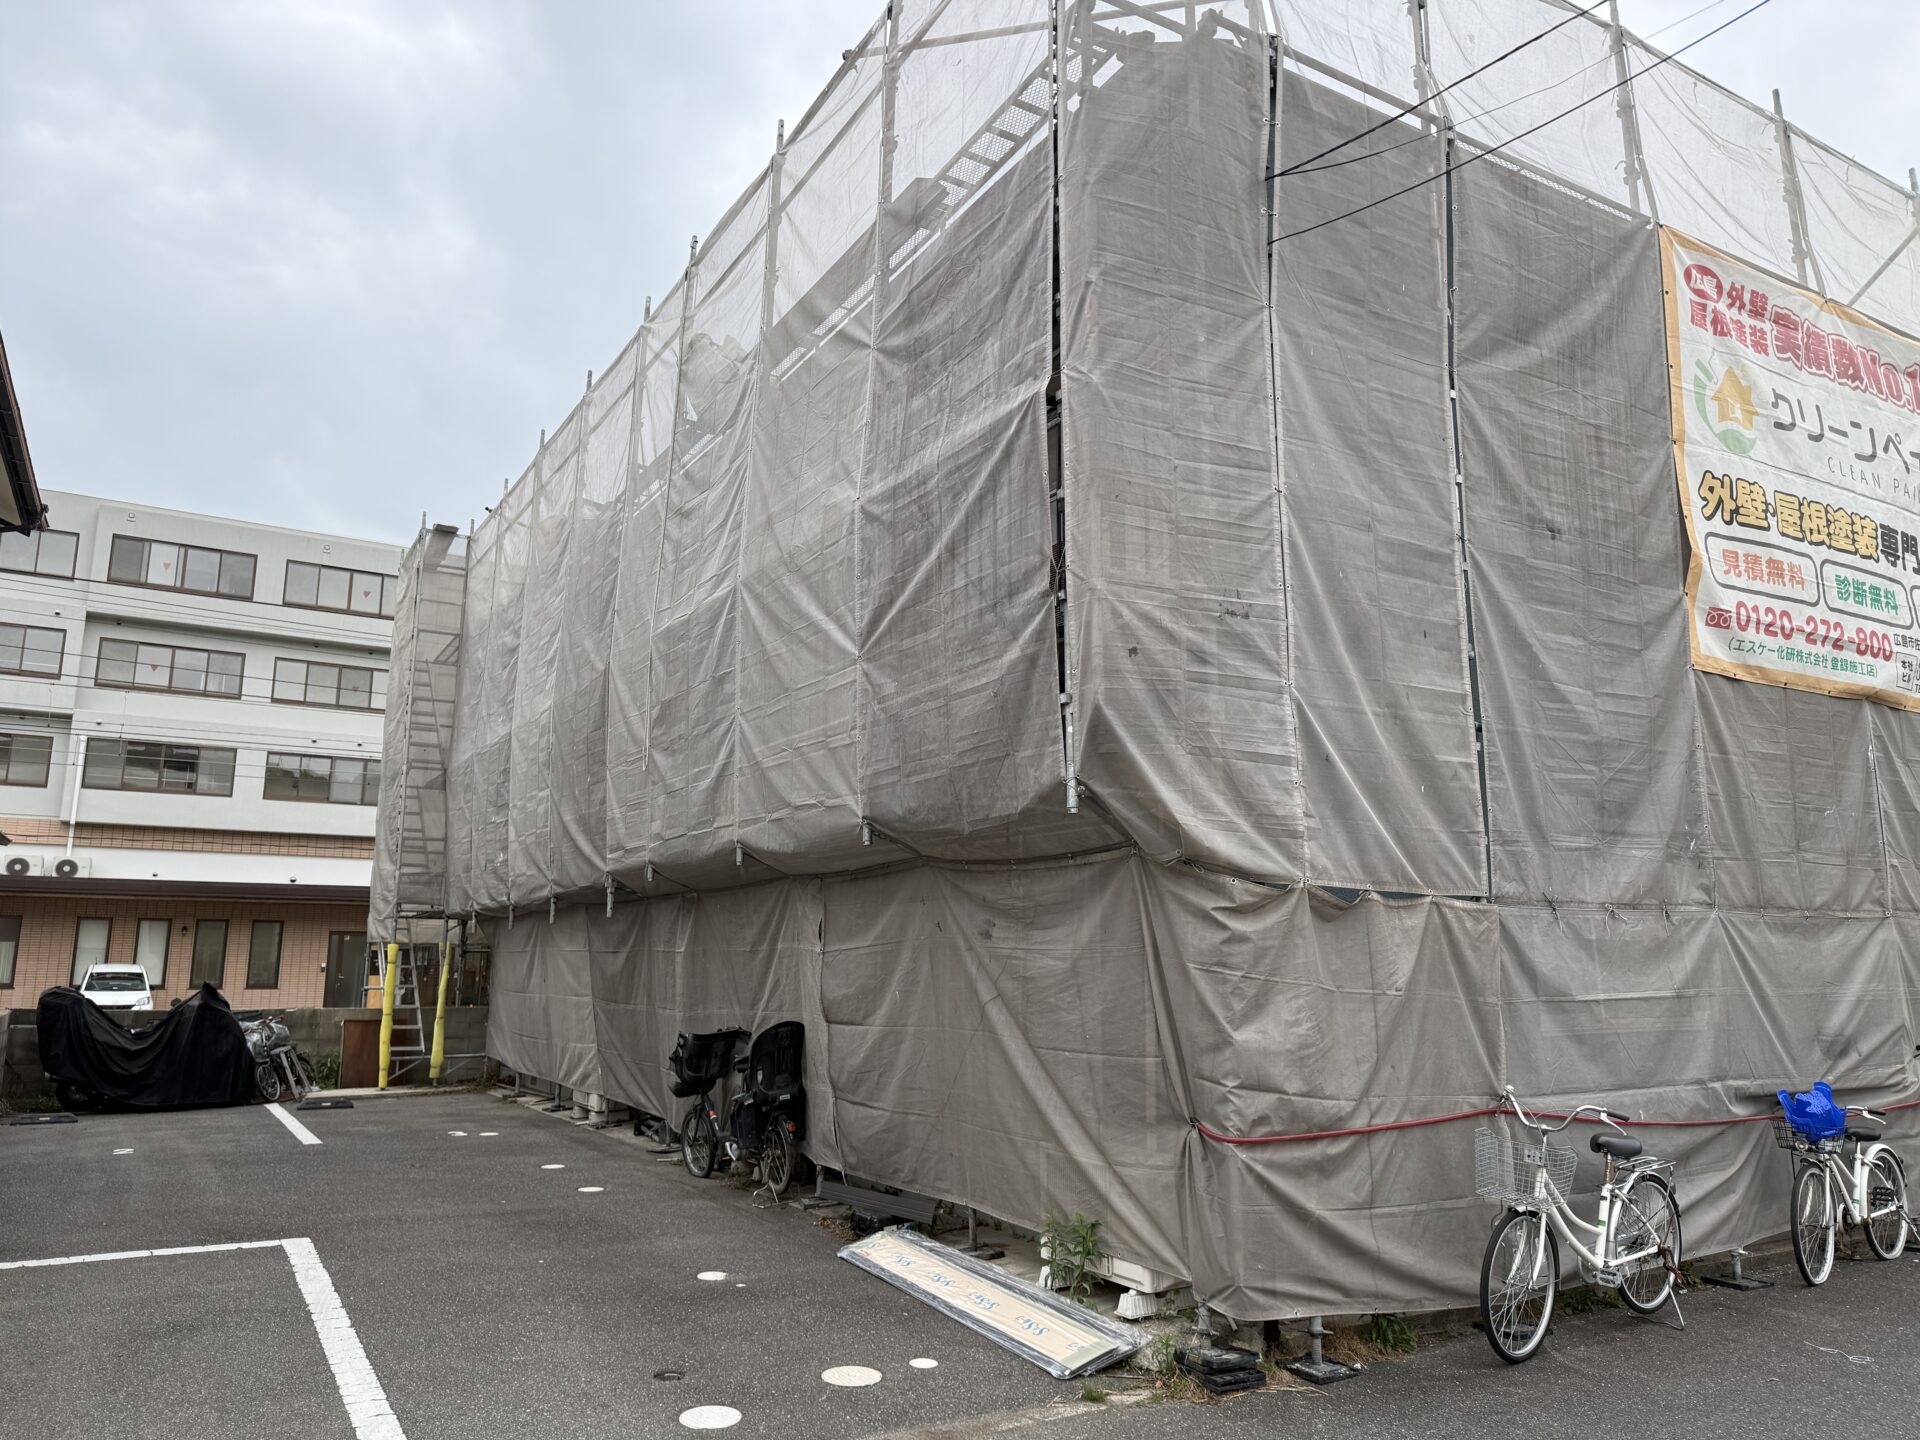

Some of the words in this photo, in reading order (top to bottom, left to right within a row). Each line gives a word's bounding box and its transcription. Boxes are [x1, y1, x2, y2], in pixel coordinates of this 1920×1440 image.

[1726, 281, 1769, 323] 外壁
[1689, 298, 1769, 357] 屋根塗装
[1827, 456, 1881, 489] CLEAN
[1893, 477, 1920, 505] PAI
[1721, 548, 1805, 592] 見積無料
[1834, 574, 1899, 616] 診断無料
[1735, 600, 1894, 662] 0120-272-800
